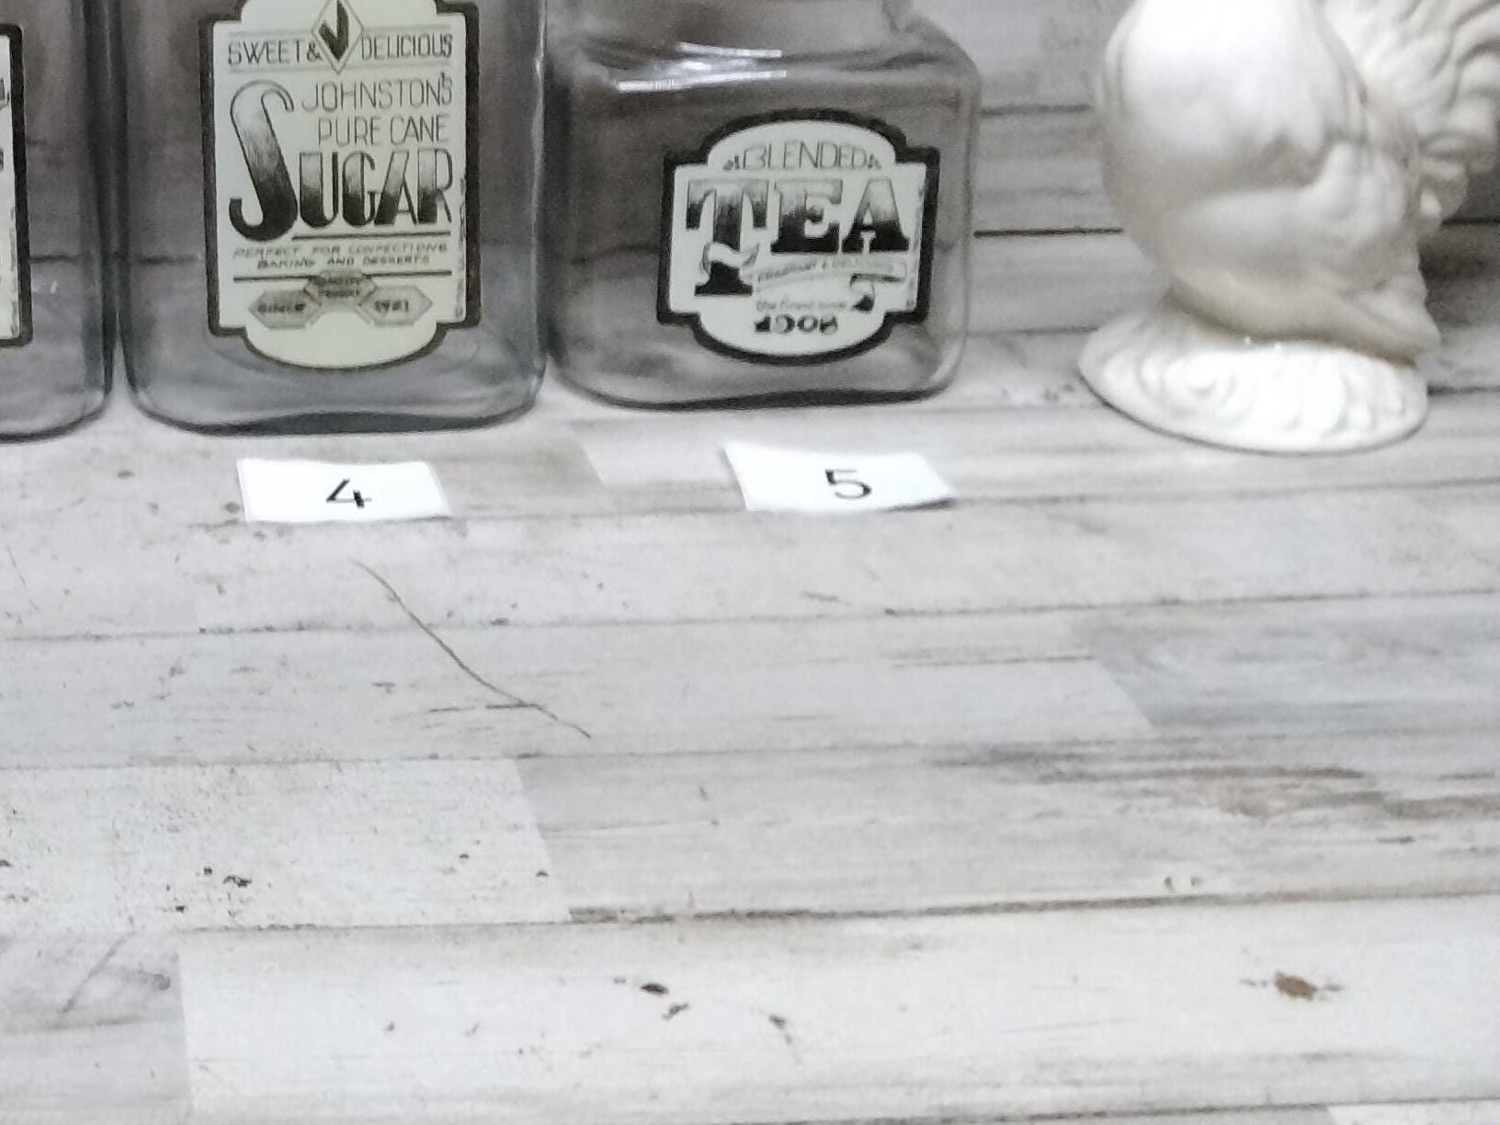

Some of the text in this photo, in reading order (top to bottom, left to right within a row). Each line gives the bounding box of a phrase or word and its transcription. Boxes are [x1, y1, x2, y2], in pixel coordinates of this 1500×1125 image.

[228, 33, 453, 65] SWEET & DELICIOUS
[301, 73, 452, 112] JOHNSTON'S
[318, 114, 450, 145] PURE CANE
[229, 79, 453, 242] SUGAR
[312, 245, 341, 255] FOR
[686, 178, 909, 297] TEA
[327, 256, 354, 266] AND
[326, 478, 373, 510] 4
[825, 468, 873, 500] 5
